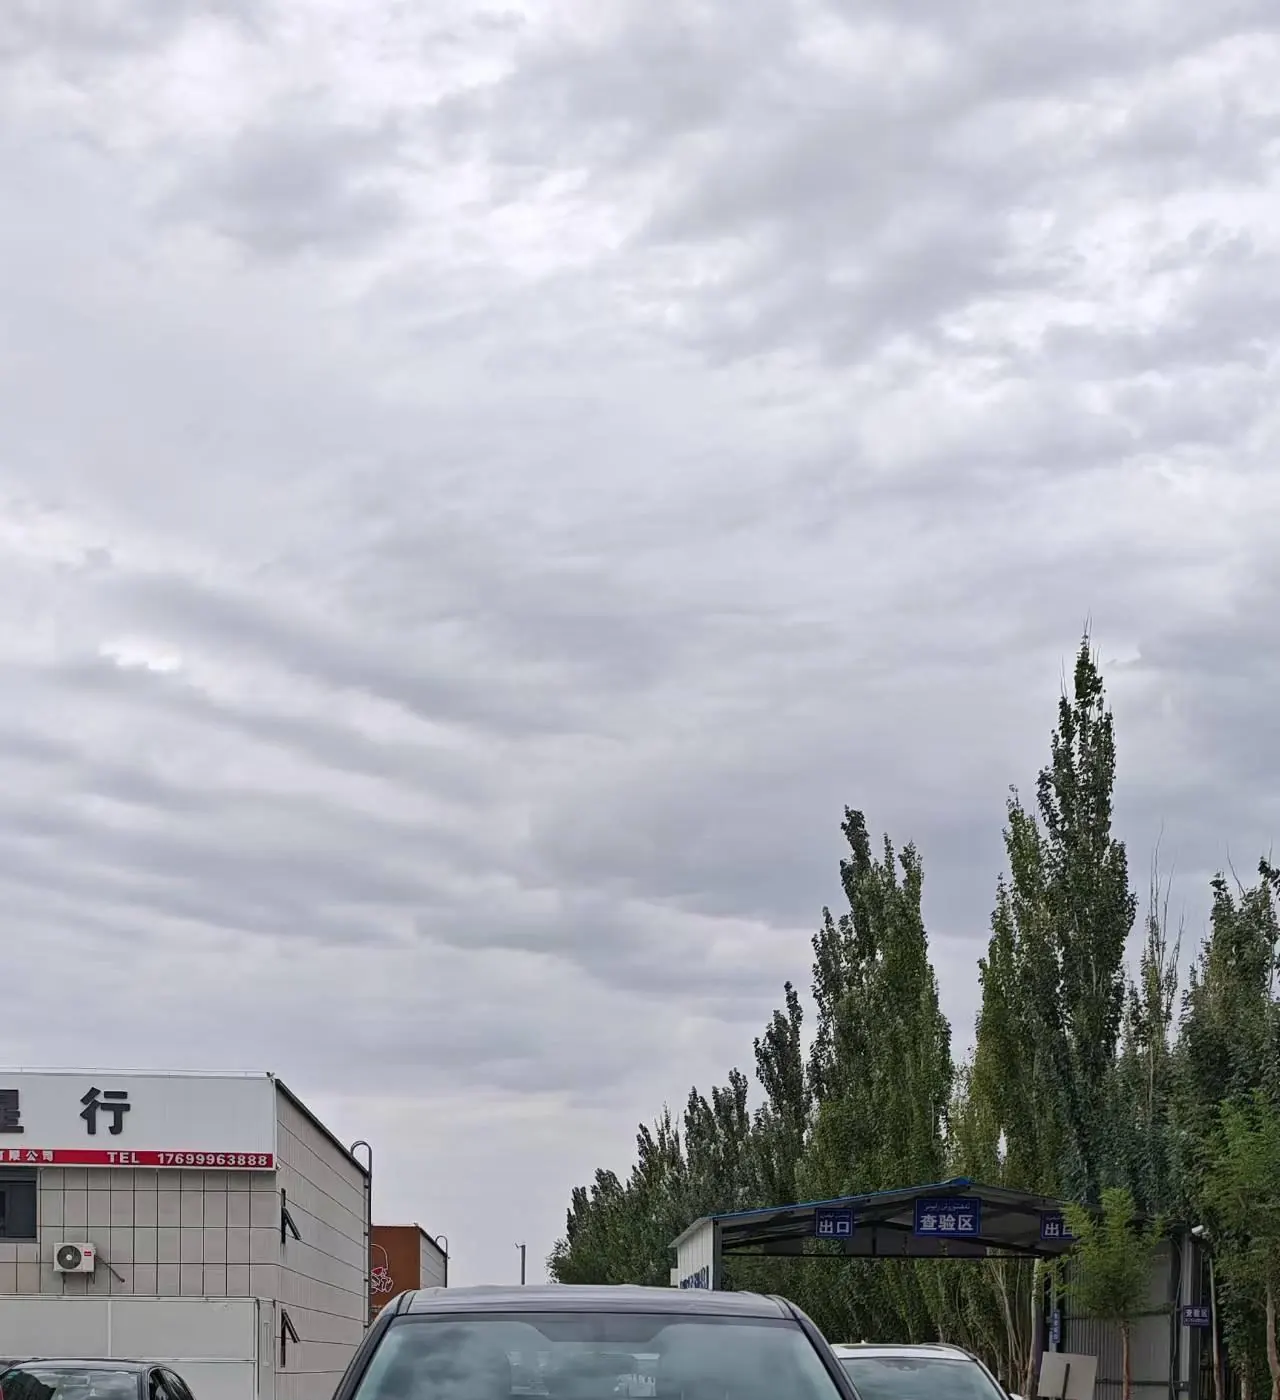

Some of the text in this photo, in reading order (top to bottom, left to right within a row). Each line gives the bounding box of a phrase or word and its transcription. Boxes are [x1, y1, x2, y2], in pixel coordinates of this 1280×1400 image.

[107, 1152, 140, 1163] TEL
[157, 1153, 268, 1165] 17699963888
[819, 1219, 849, 1234] 出口
[919, 1214, 974, 1231] 查验区
